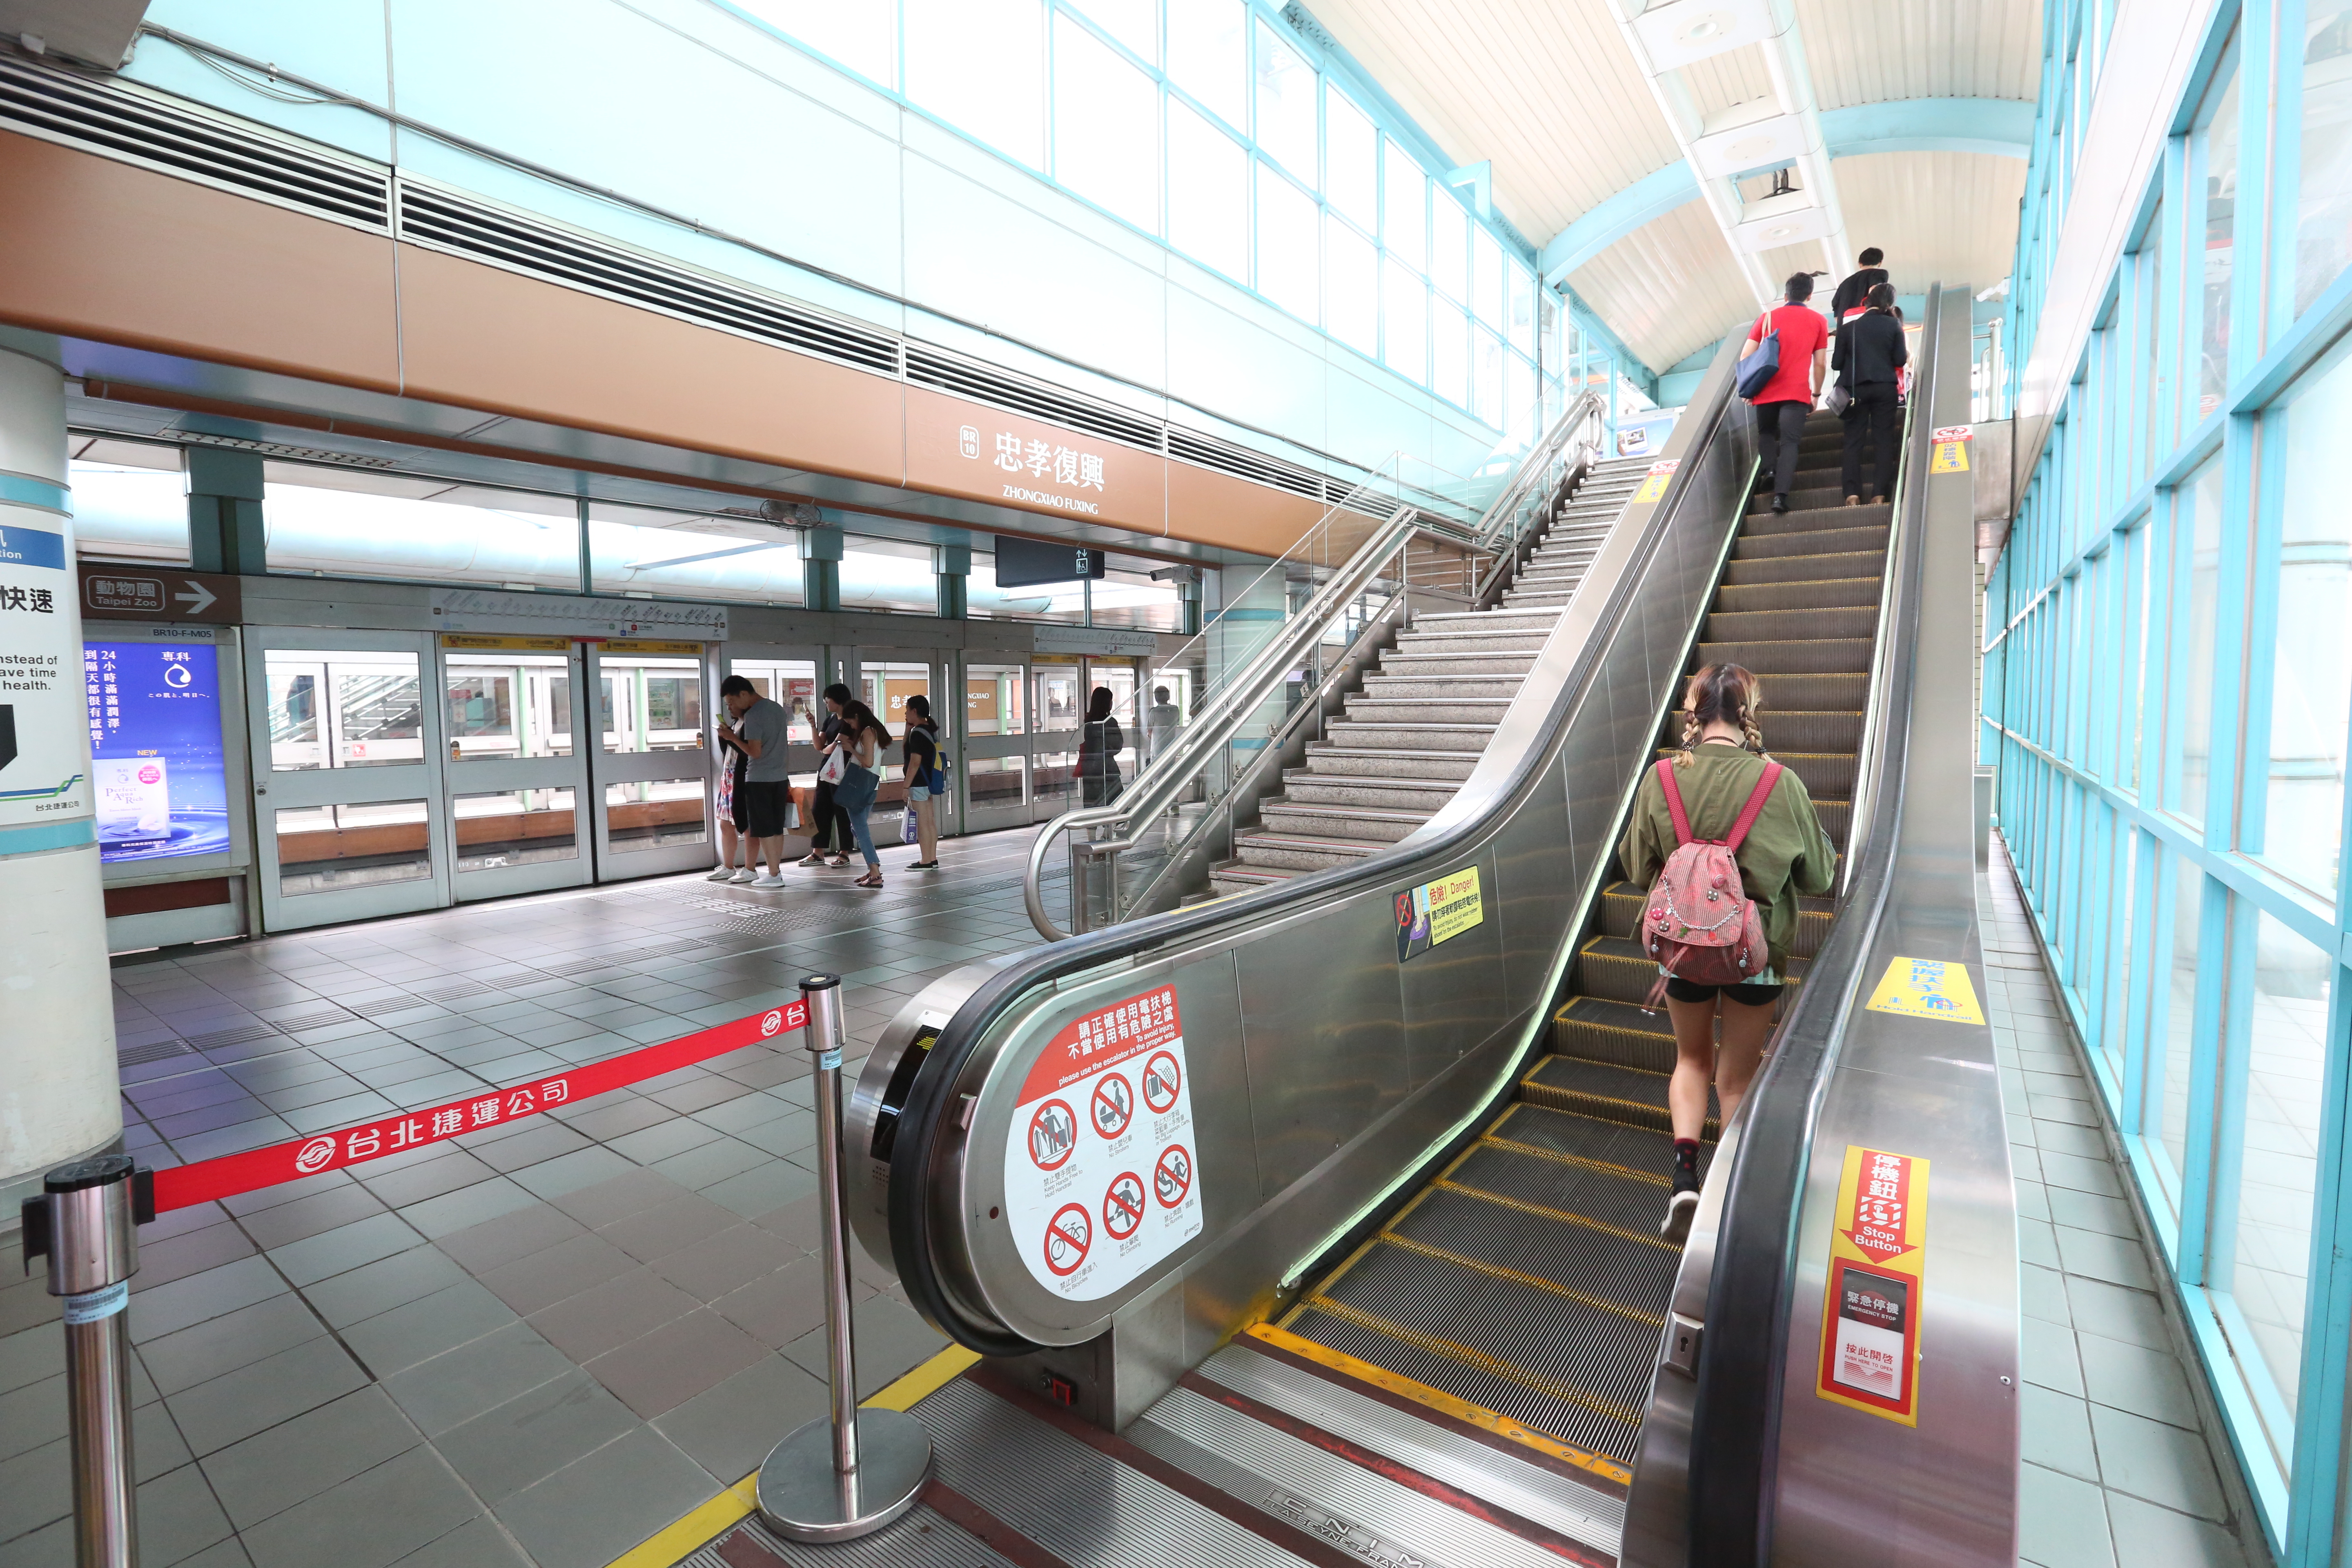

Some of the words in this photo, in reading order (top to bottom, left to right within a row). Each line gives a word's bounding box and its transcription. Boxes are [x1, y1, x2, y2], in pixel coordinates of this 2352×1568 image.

[963, 430, 976, 442] BR
[964, 443, 975, 454] 10
[994, 432, 1105, 492] 忠孝復興
[1003, 485, 1062, 507] ZHONGXIAO
[1065, 498, 1098, 514] FUXING
[96, 580, 156, 597] 動物園
[96, 597, 131, 606] Taipei
[135, 598, 157, 607] Zoo
[153, 629, 212, 638] BR10-F-M05
[47, 655, 58, 665] of
[30, 668, 56, 677] time
[3, 680, 51, 690] health.
[105, 787, 136, 797] Perfect
[113, 792, 133, 801] Aqua
[36, 801, 79, 811] 台北捷運公司
[1450, 875, 1474, 894] Danger!
[1907, 960, 1946, 992] 緊握扶手
[787, 1004, 805, 1027] 台
[1078, 990, 1172, 1040] 請正確使用電扶梯
[1913, 1009, 1972, 1020] Handrail
[1067, 1006, 1174, 1060] 不當使用有危險之虞
[1136, 1035, 1143, 1043] To
[1144, 1028, 1158, 1040] avoid
[1159, 1023, 1174, 1035] injury,
[1058, 1073, 1079, 1087] please
[1080, 1066, 1091, 1076] use
[1092, 1062, 1102, 1071] the
[1103, 1050, 1129, 1066] escalator
[1130, 1046, 1136, 1055] in
[1136, 1041, 1145, 1052] the
[1146, 1035, 1164, 1049] proper
[1164, 1030, 1176, 1041] way.
[347, 1079, 568, 1159] 台北捷運公司
[1109, 1134, 1132, 1153] 禁止嬰兒車
[1115, 1145, 1129, 1155] Strollers
[1045, 1185, 1055, 1193] Keep
[1056, 1177, 1069, 1187] Hands
[1869, 1154, 1901, 1200] 停機鈕
[1045, 1190, 1055, 1199] Hold
[1056, 1180, 1072, 1193] Handrail
[1170, 1214, 1183, 1225] Running
[1863, 1226, 1895, 1242] Stop
[1126, 1242, 1141, 1254] Climbing
[1855, 1234, 1902, 1254] Button
[1060, 1262, 1098, 1291] 禁止自行車進入
[1072, 1276, 1088, 1290] Bicycles
[1847, 1291, 1899, 1315] 緊急停機
[1848, 1304, 1880, 1317] EMERGENCY
[1270, 1503, 1290, 1517] LA
[1296, 1516, 1351, 1548] SEYNE
